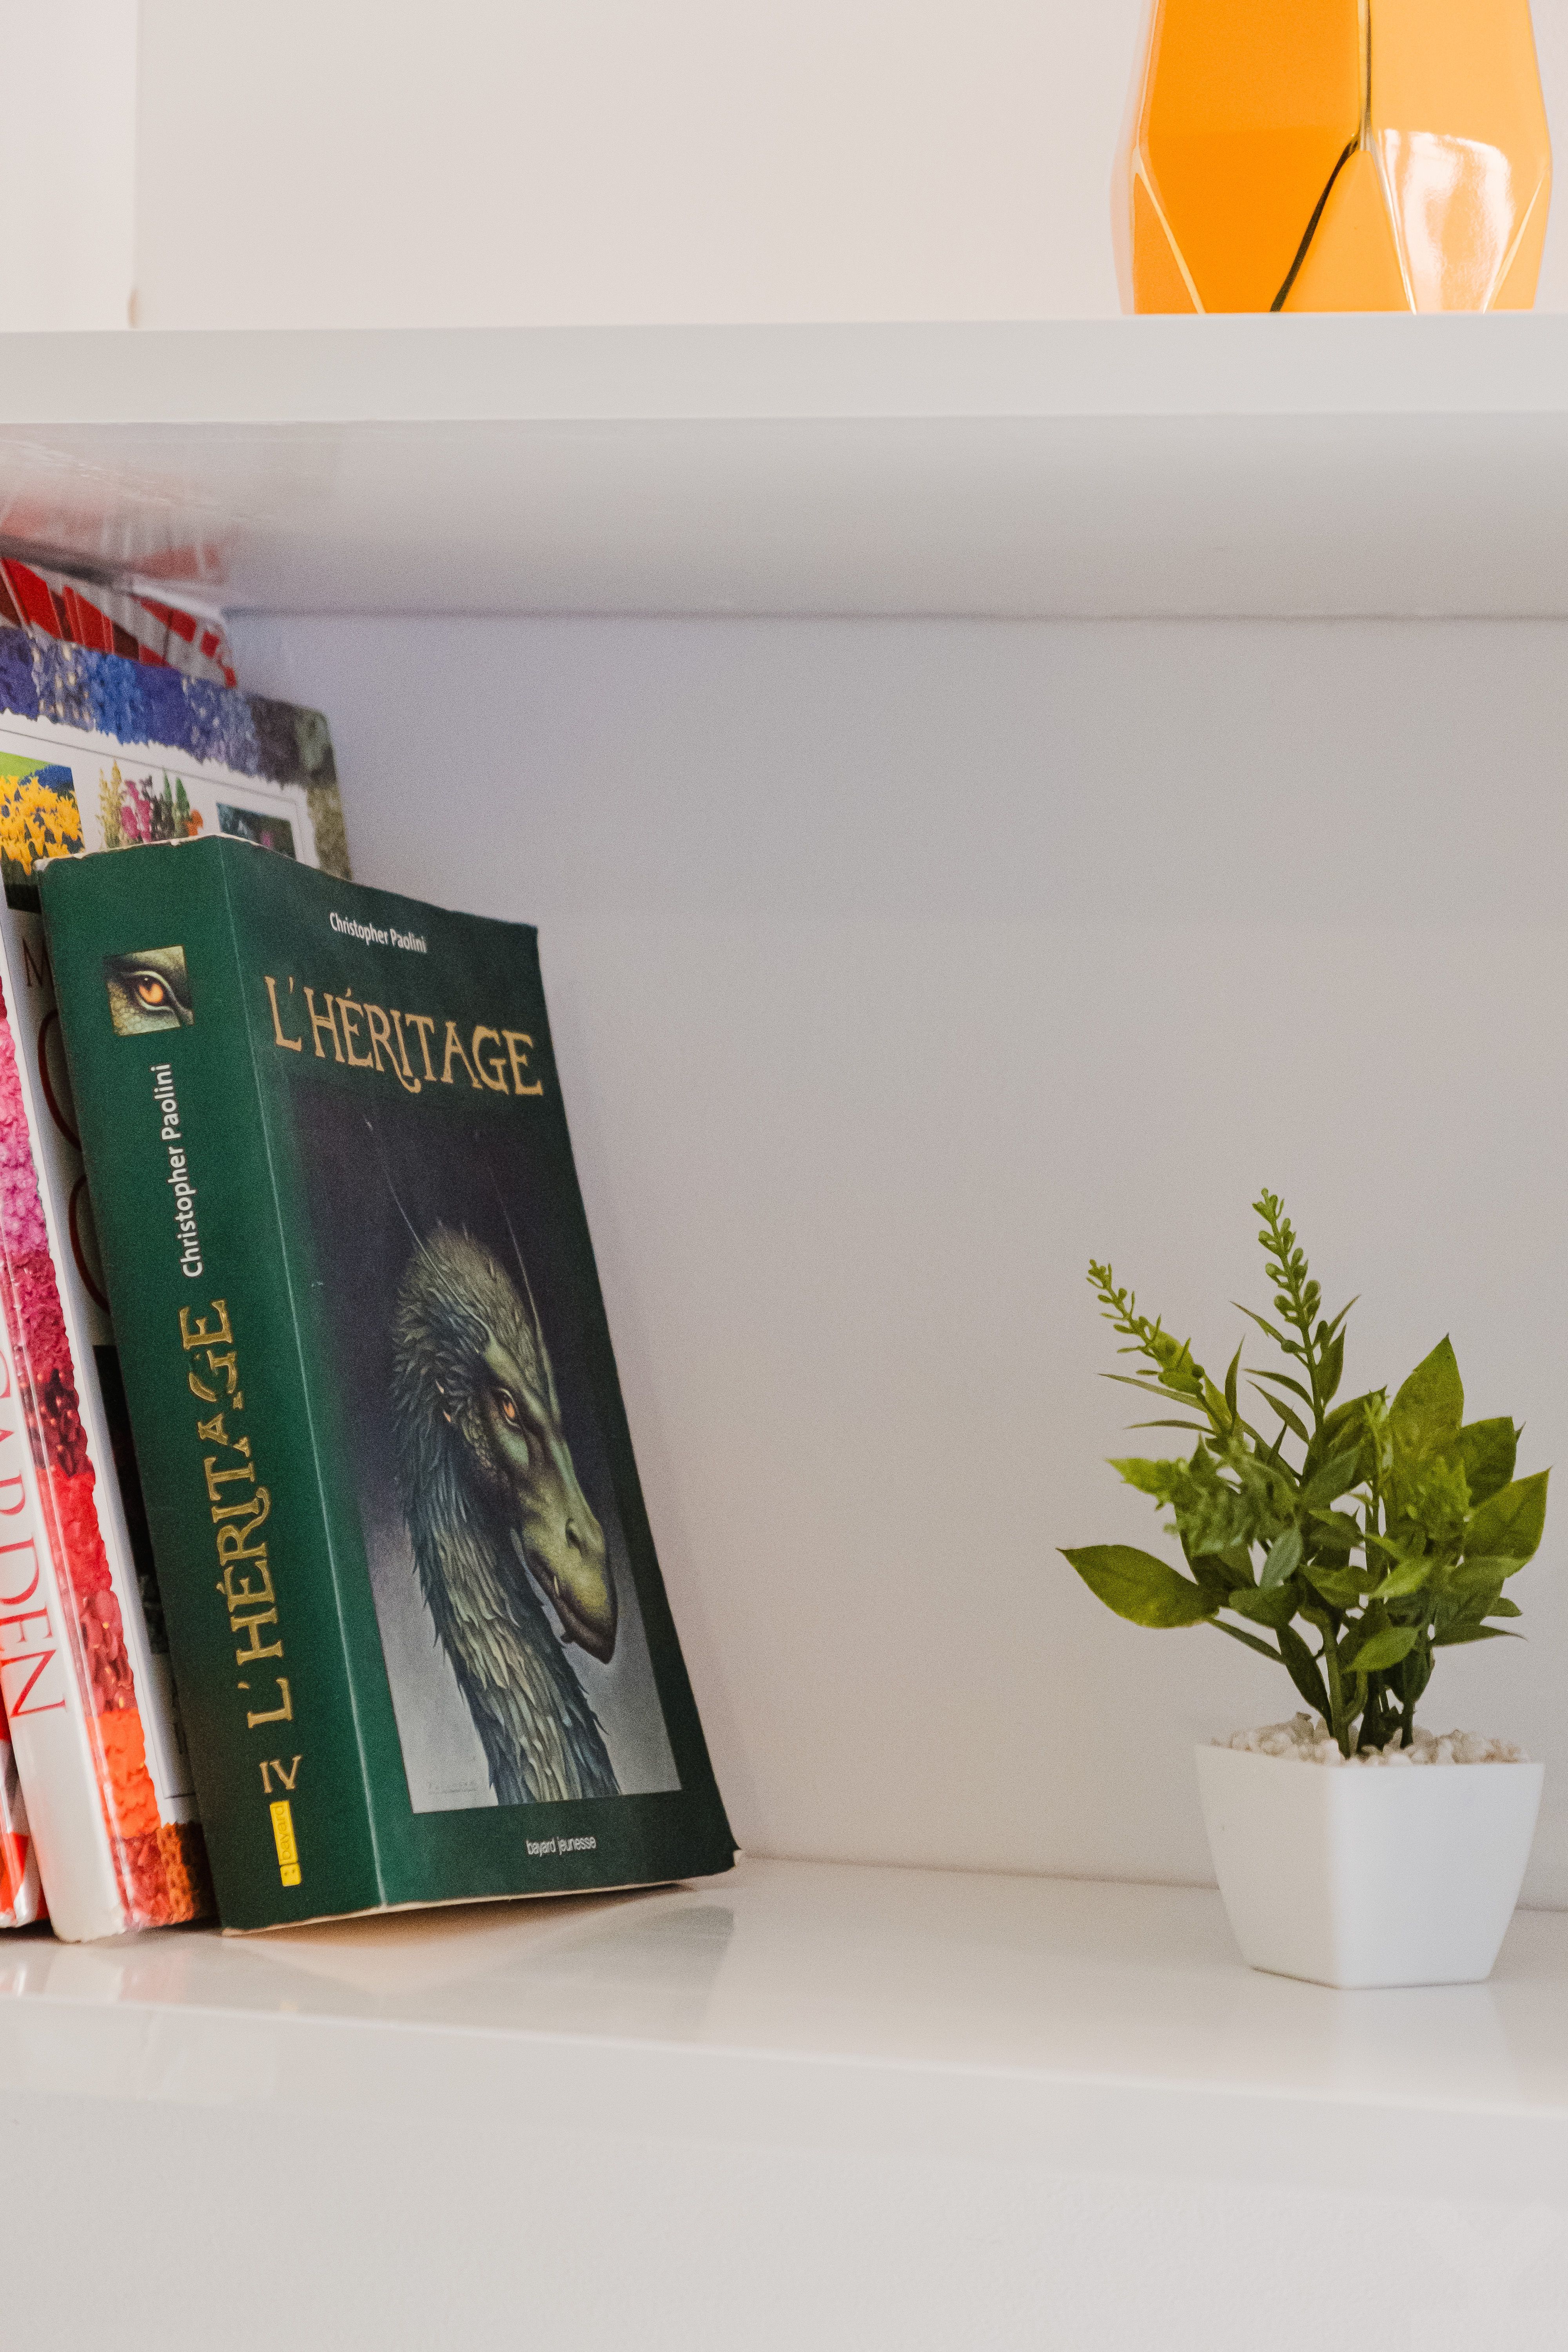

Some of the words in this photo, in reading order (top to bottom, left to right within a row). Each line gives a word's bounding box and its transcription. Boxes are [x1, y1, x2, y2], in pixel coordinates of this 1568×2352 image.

[330, 912, 388, 946] Christopher
[390, 928, 427, 953] Paolini
[264, 975, 543, 1096] L'HÉRITAGE
[150, 1063, 181, 1141] Paolini
[168, 1146, 203, 1278] Christopher
[180, 1298, 293, 1728] L'HÉRITAGE
[259, 1755, 301, 1793] IV
[272, 1805, 291, 1860] bayard
[526, 1838, 556, 1857] bayard
[557, 1837, 596, 1855] jeunesse
